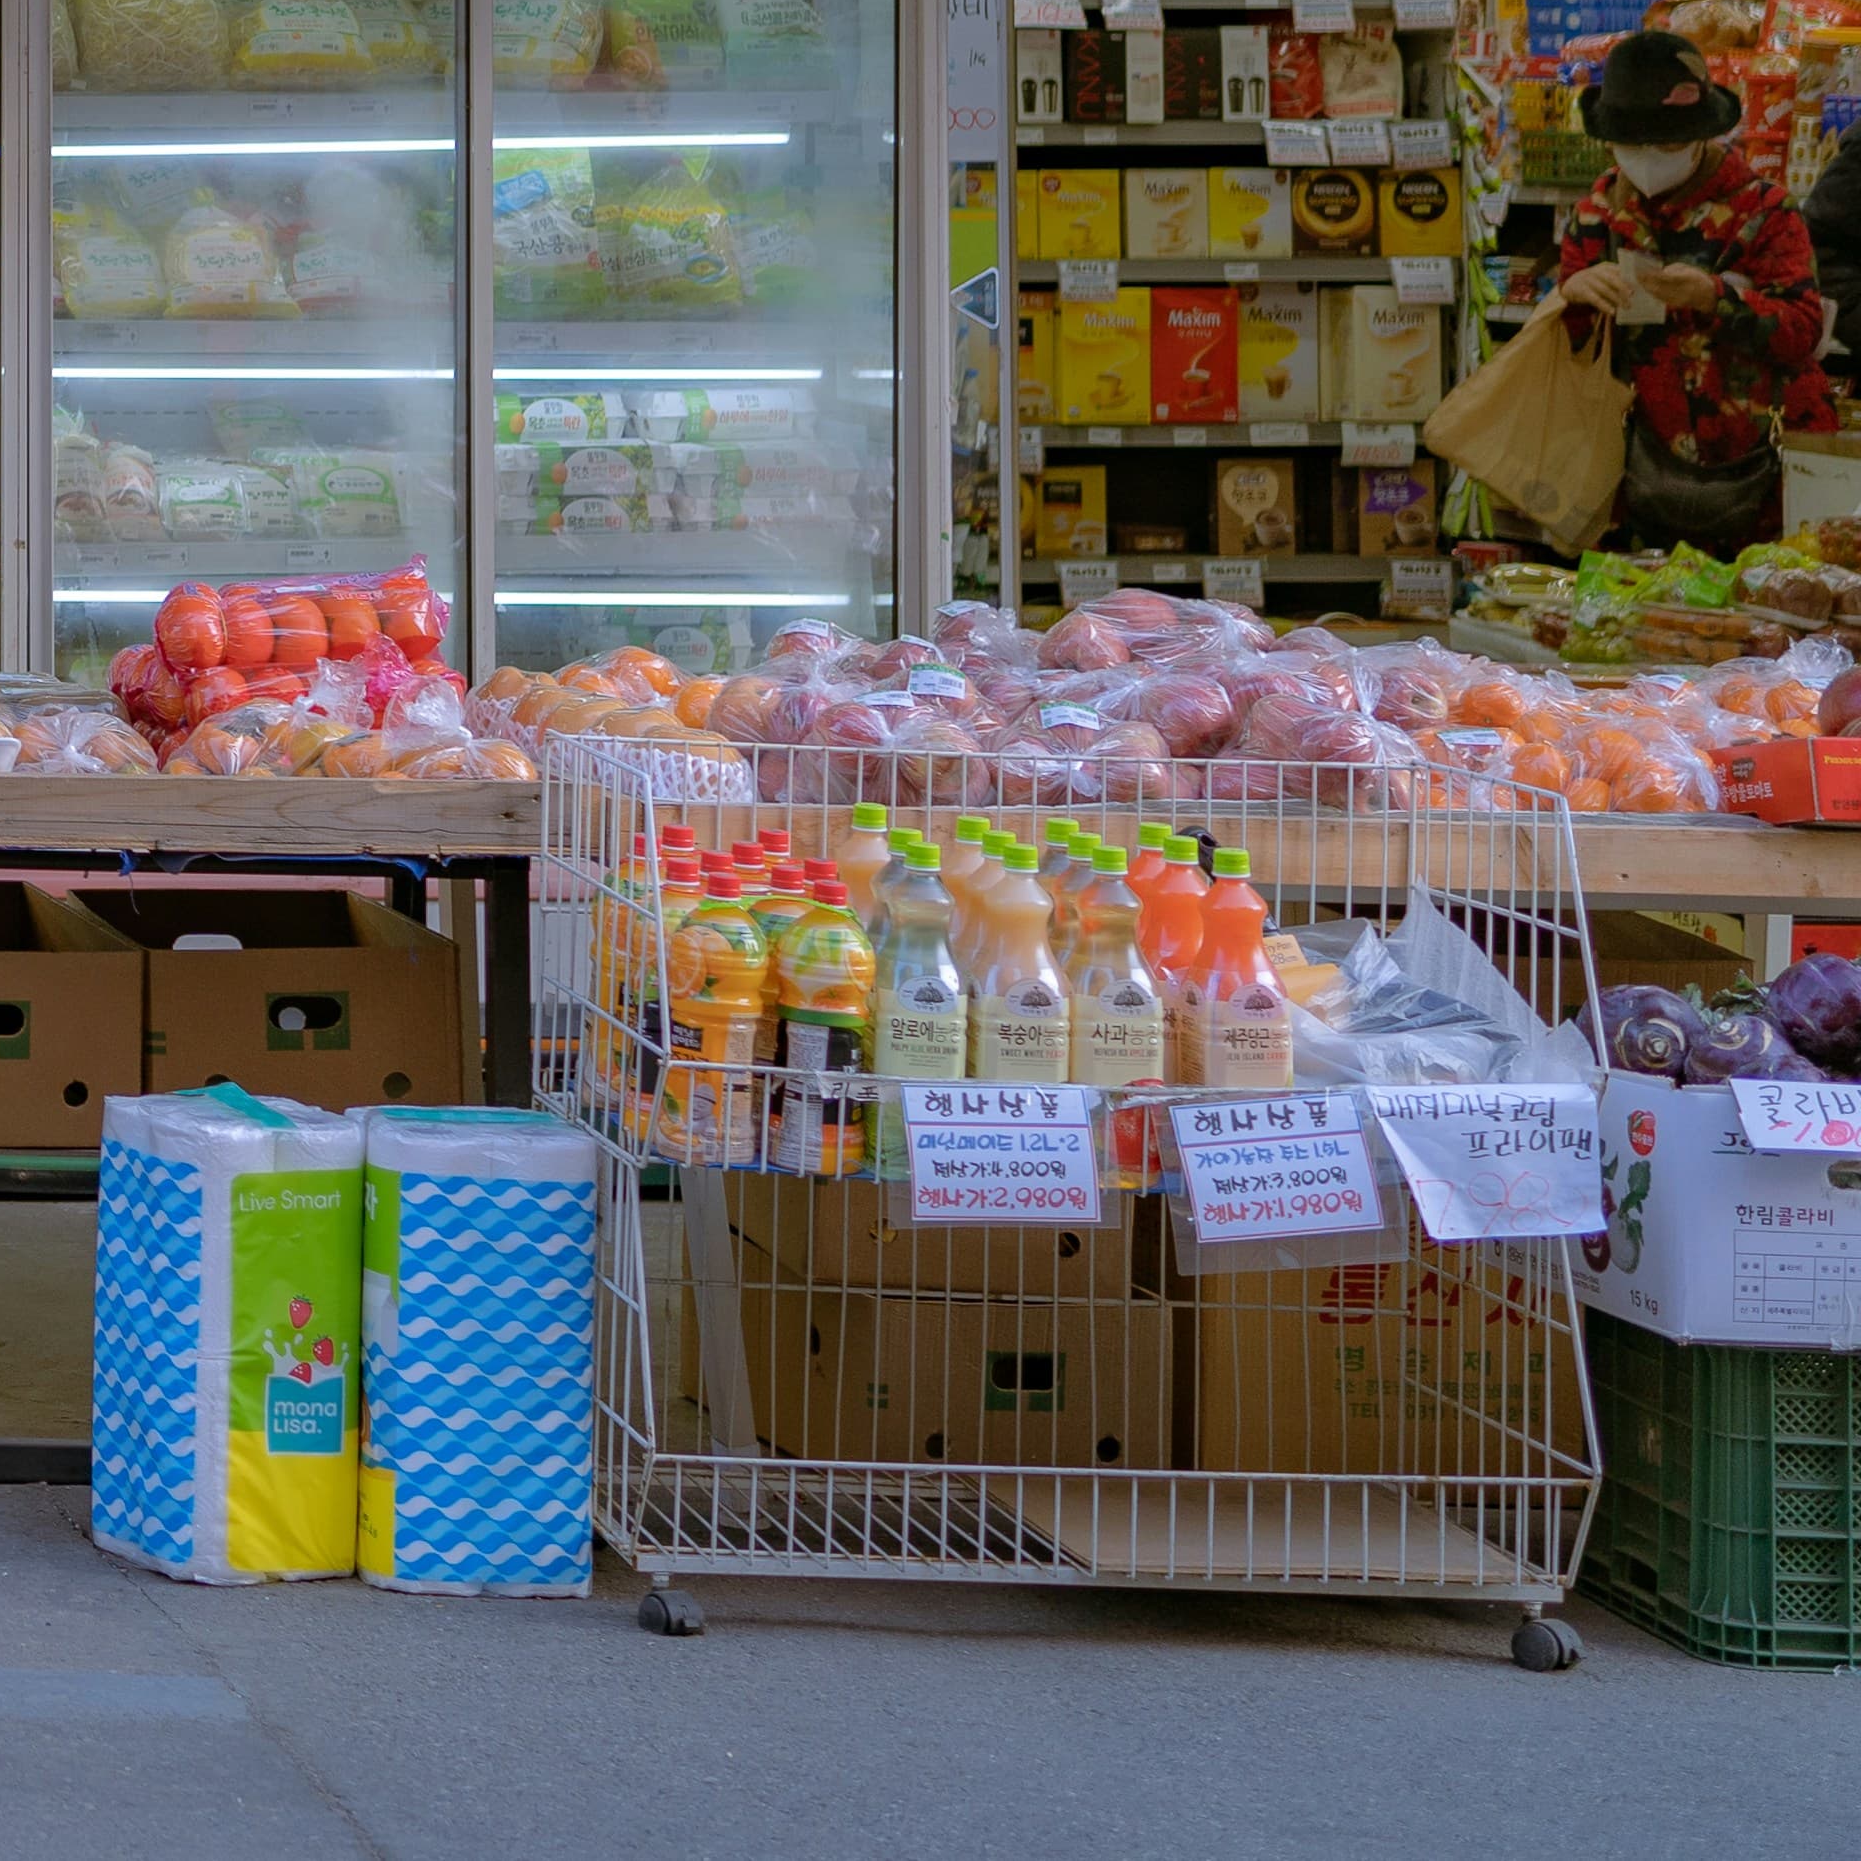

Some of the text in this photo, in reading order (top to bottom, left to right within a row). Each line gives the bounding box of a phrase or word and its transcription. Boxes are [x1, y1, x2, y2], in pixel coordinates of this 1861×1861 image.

[1167, 307, 1221, 328] Maxim
[1373, 306, 1425, 326] Maxim
[917, 1132, 1014, 1151] 미닛메이드
[1461, 1128, 1593, 1161] 프라이팬
[239, 1188, 342, 1213] Live Smart
[1735, 1203, 1835, 1228] 한림콜라비
[1629, 1289, 1659, 1316] 15 kg
[274, 1399, 338, 1416] mona
